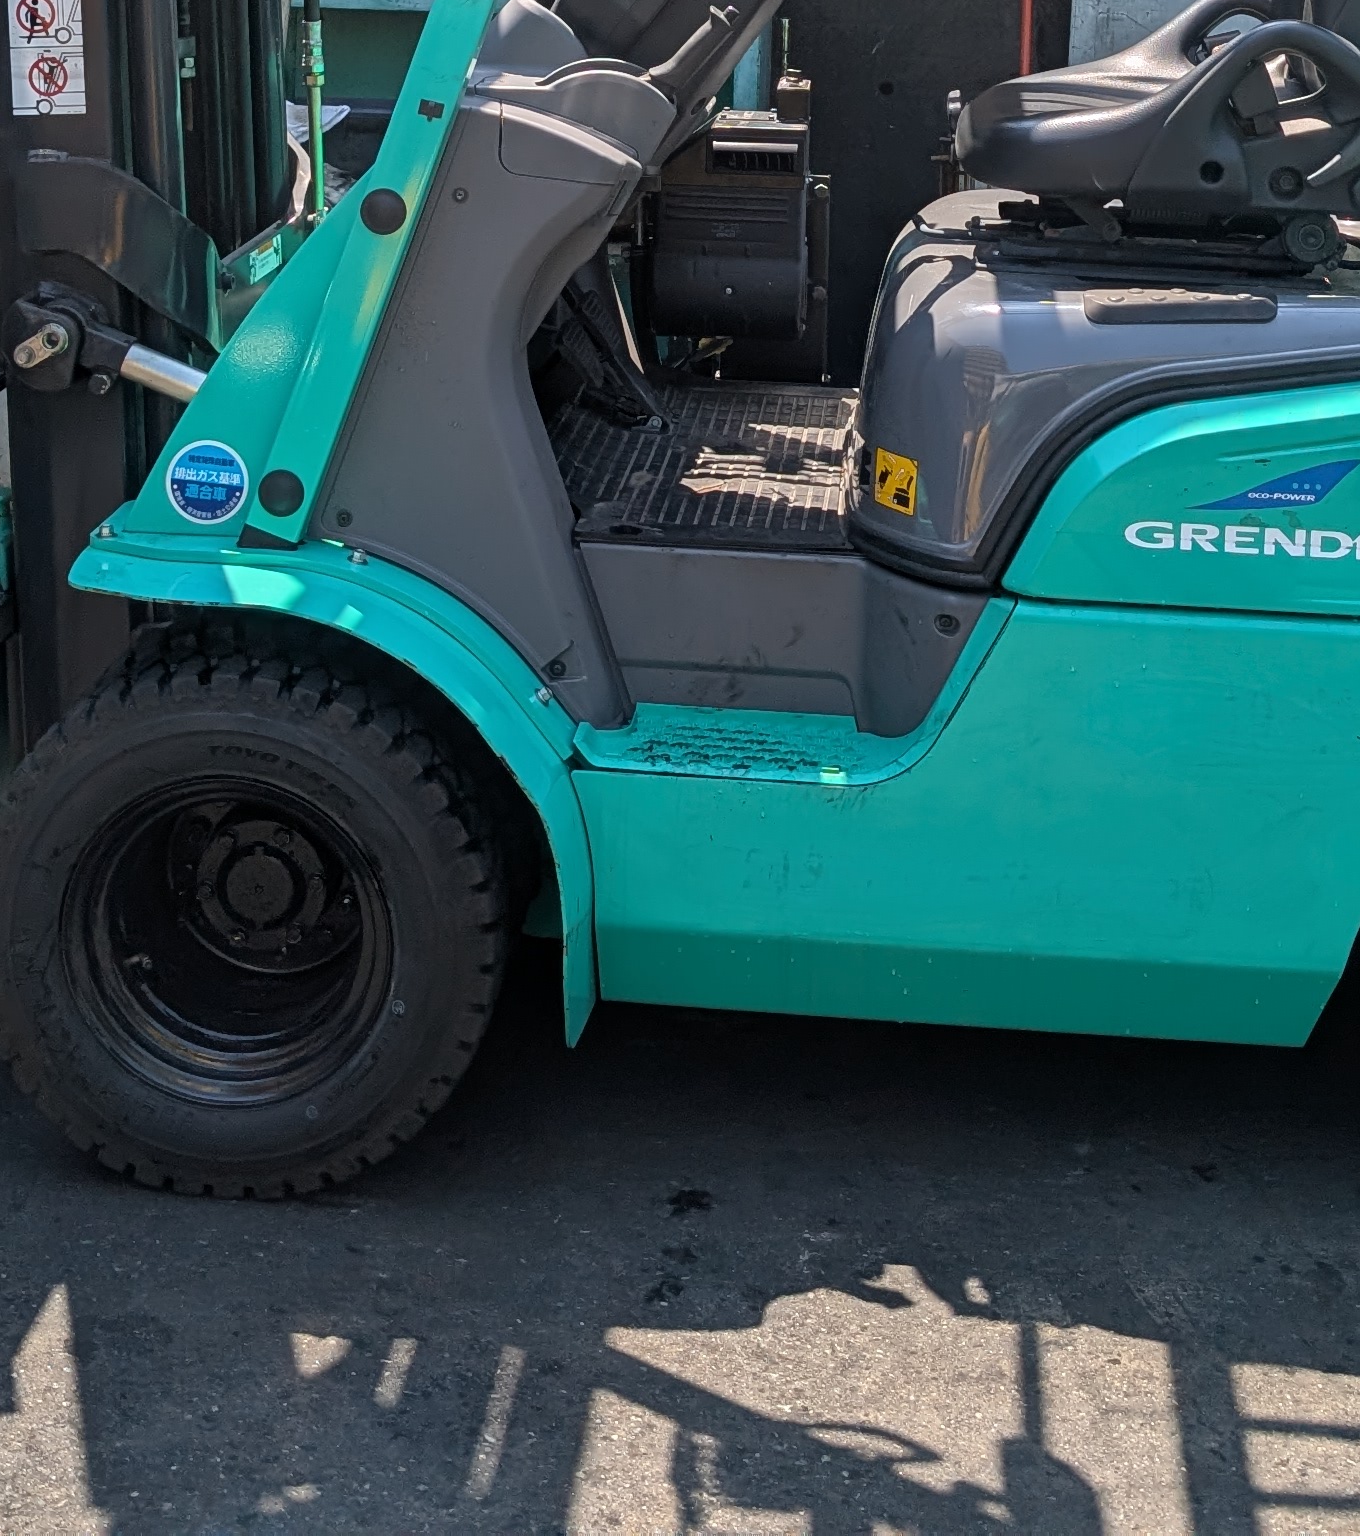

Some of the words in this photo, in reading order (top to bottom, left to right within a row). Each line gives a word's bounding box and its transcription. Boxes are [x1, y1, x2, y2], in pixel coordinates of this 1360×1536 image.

[174, 466, 241, 485] 排出ガス基準
[185, 483, 227, 501] 適合車
